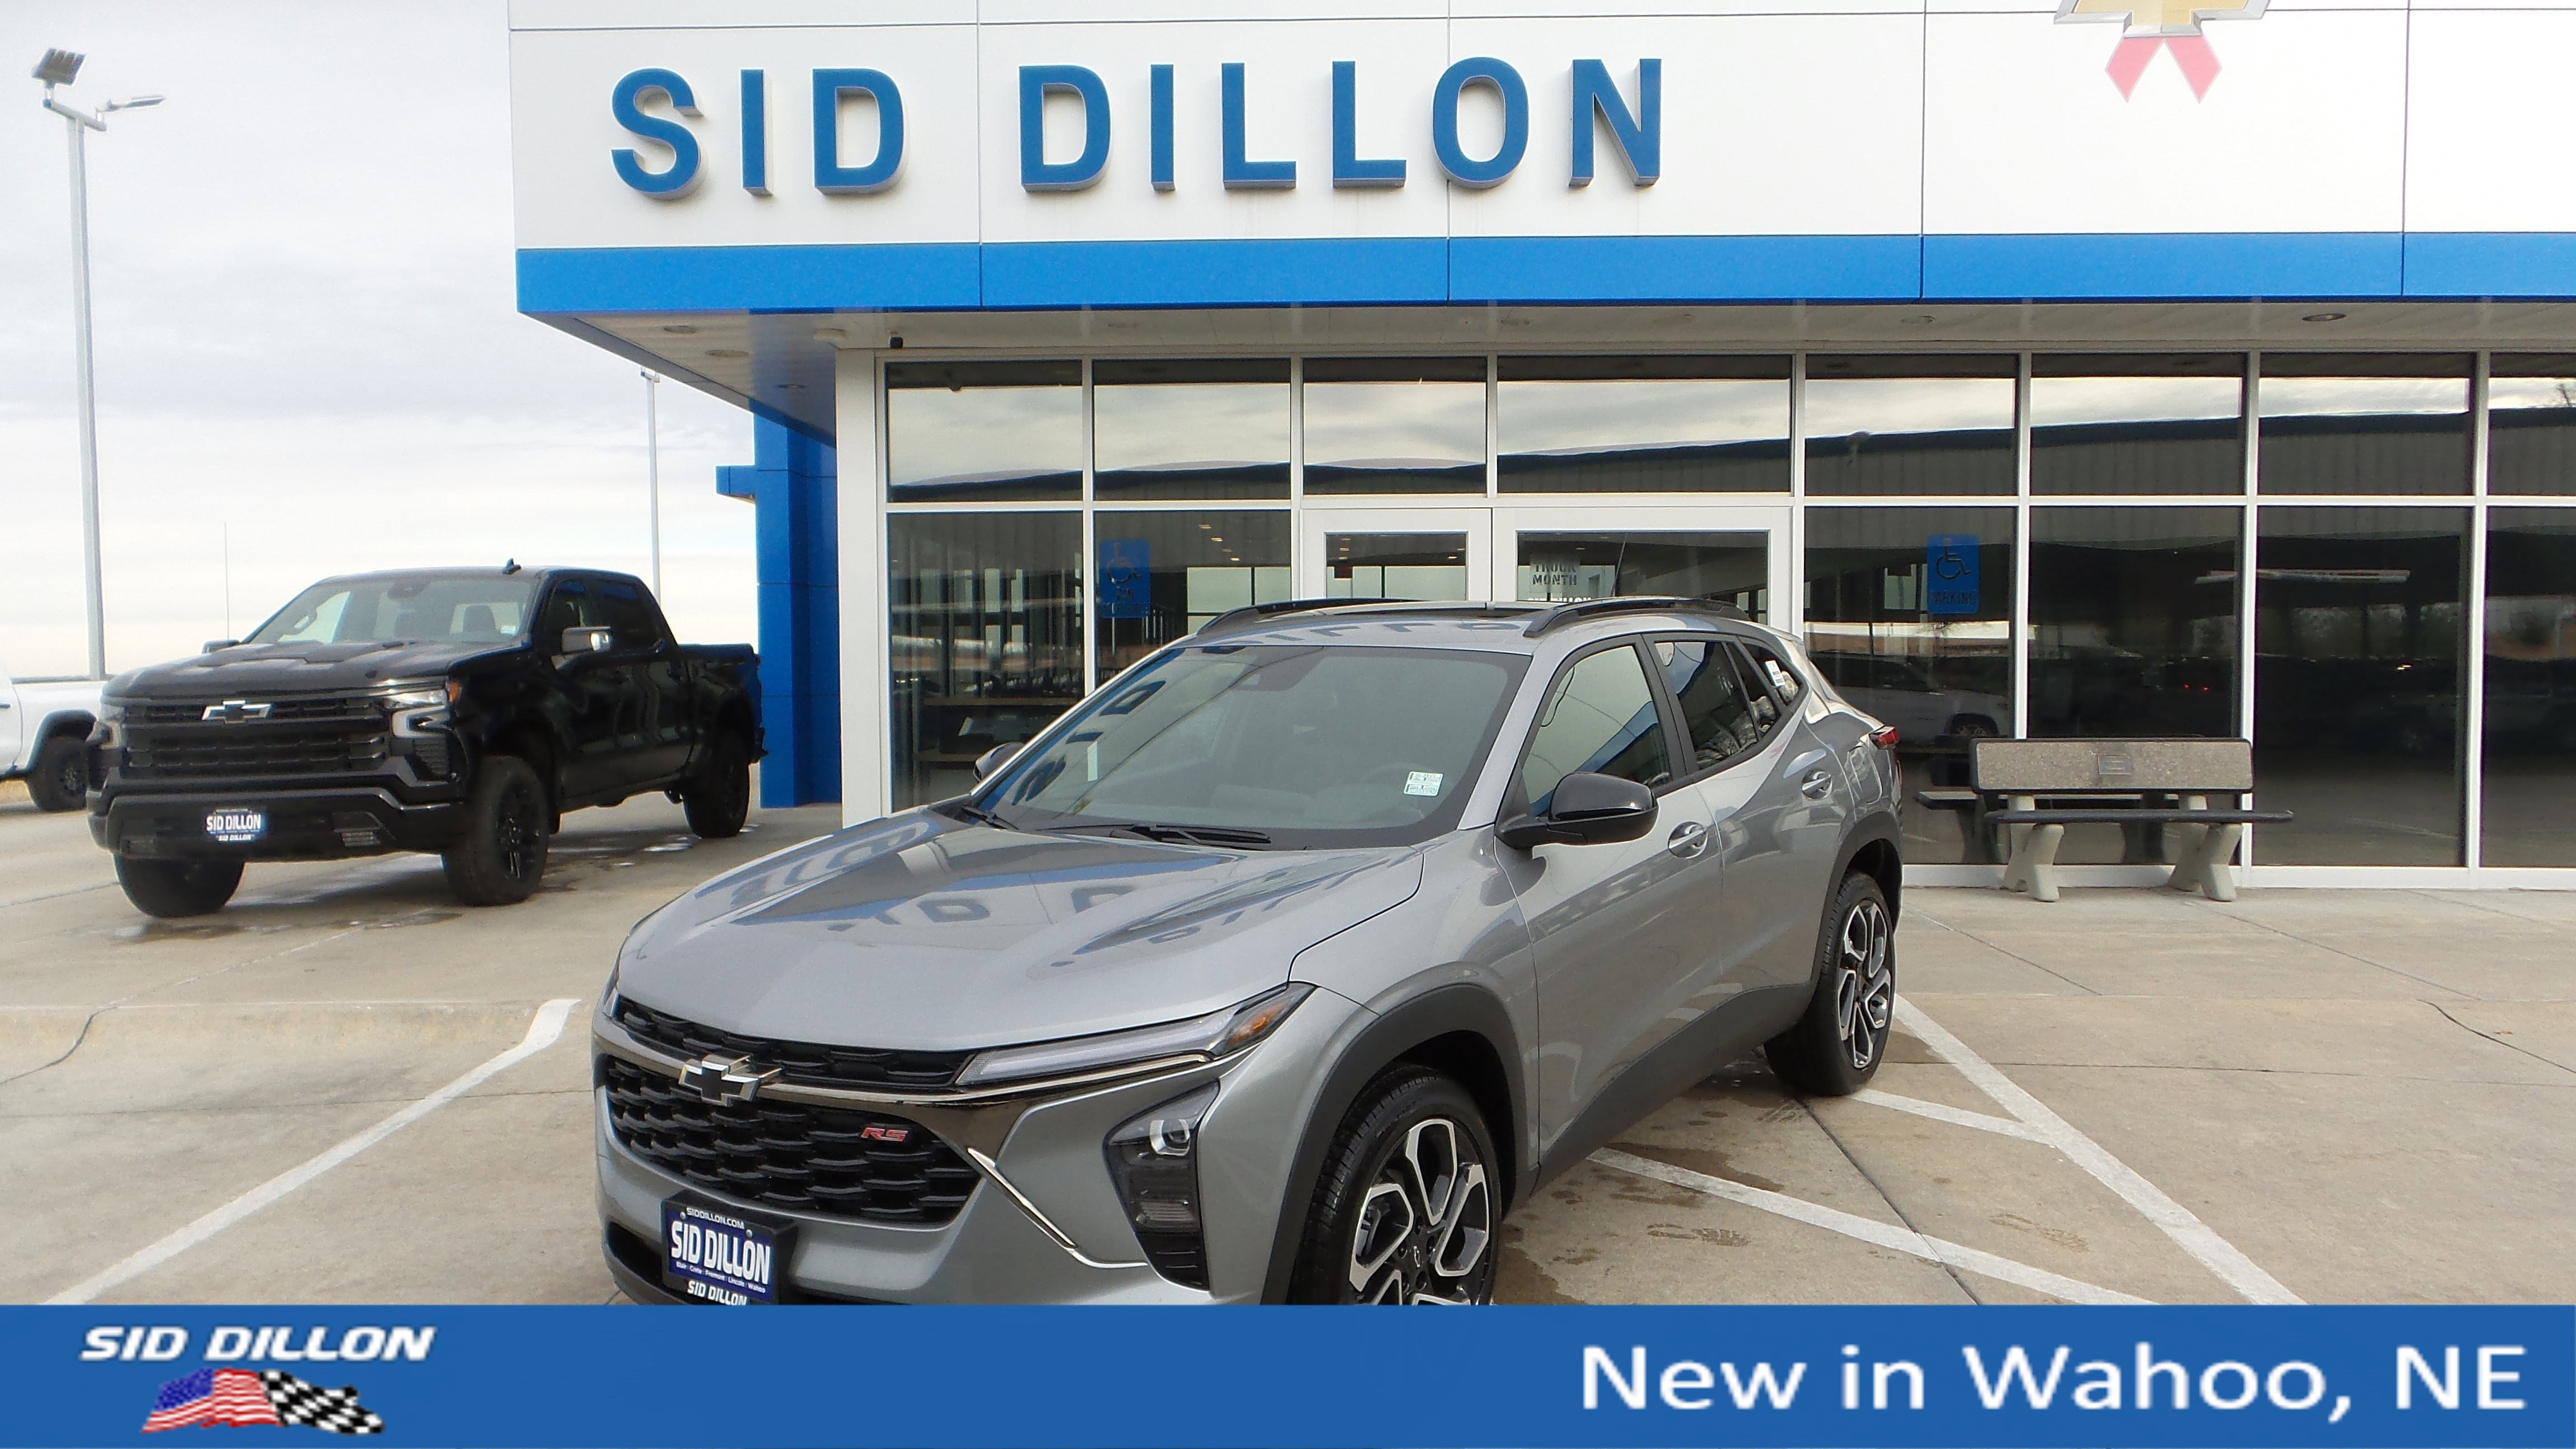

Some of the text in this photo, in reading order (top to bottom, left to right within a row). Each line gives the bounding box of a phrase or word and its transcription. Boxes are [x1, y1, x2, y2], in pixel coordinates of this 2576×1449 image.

[611, 56, 1662, 198] SID DILLON
[1532, 574, 1578, 586] MONTH
[206, 814, 261, 831] SID DILLON
[861, 1127, 908, 1142] RS
[686, 1206, 745, 1229] SIDDILLON.COM
[671, 1220, 770, 1285] SID DILLON
[687, 1280, 747, 1305] SID DILLON
